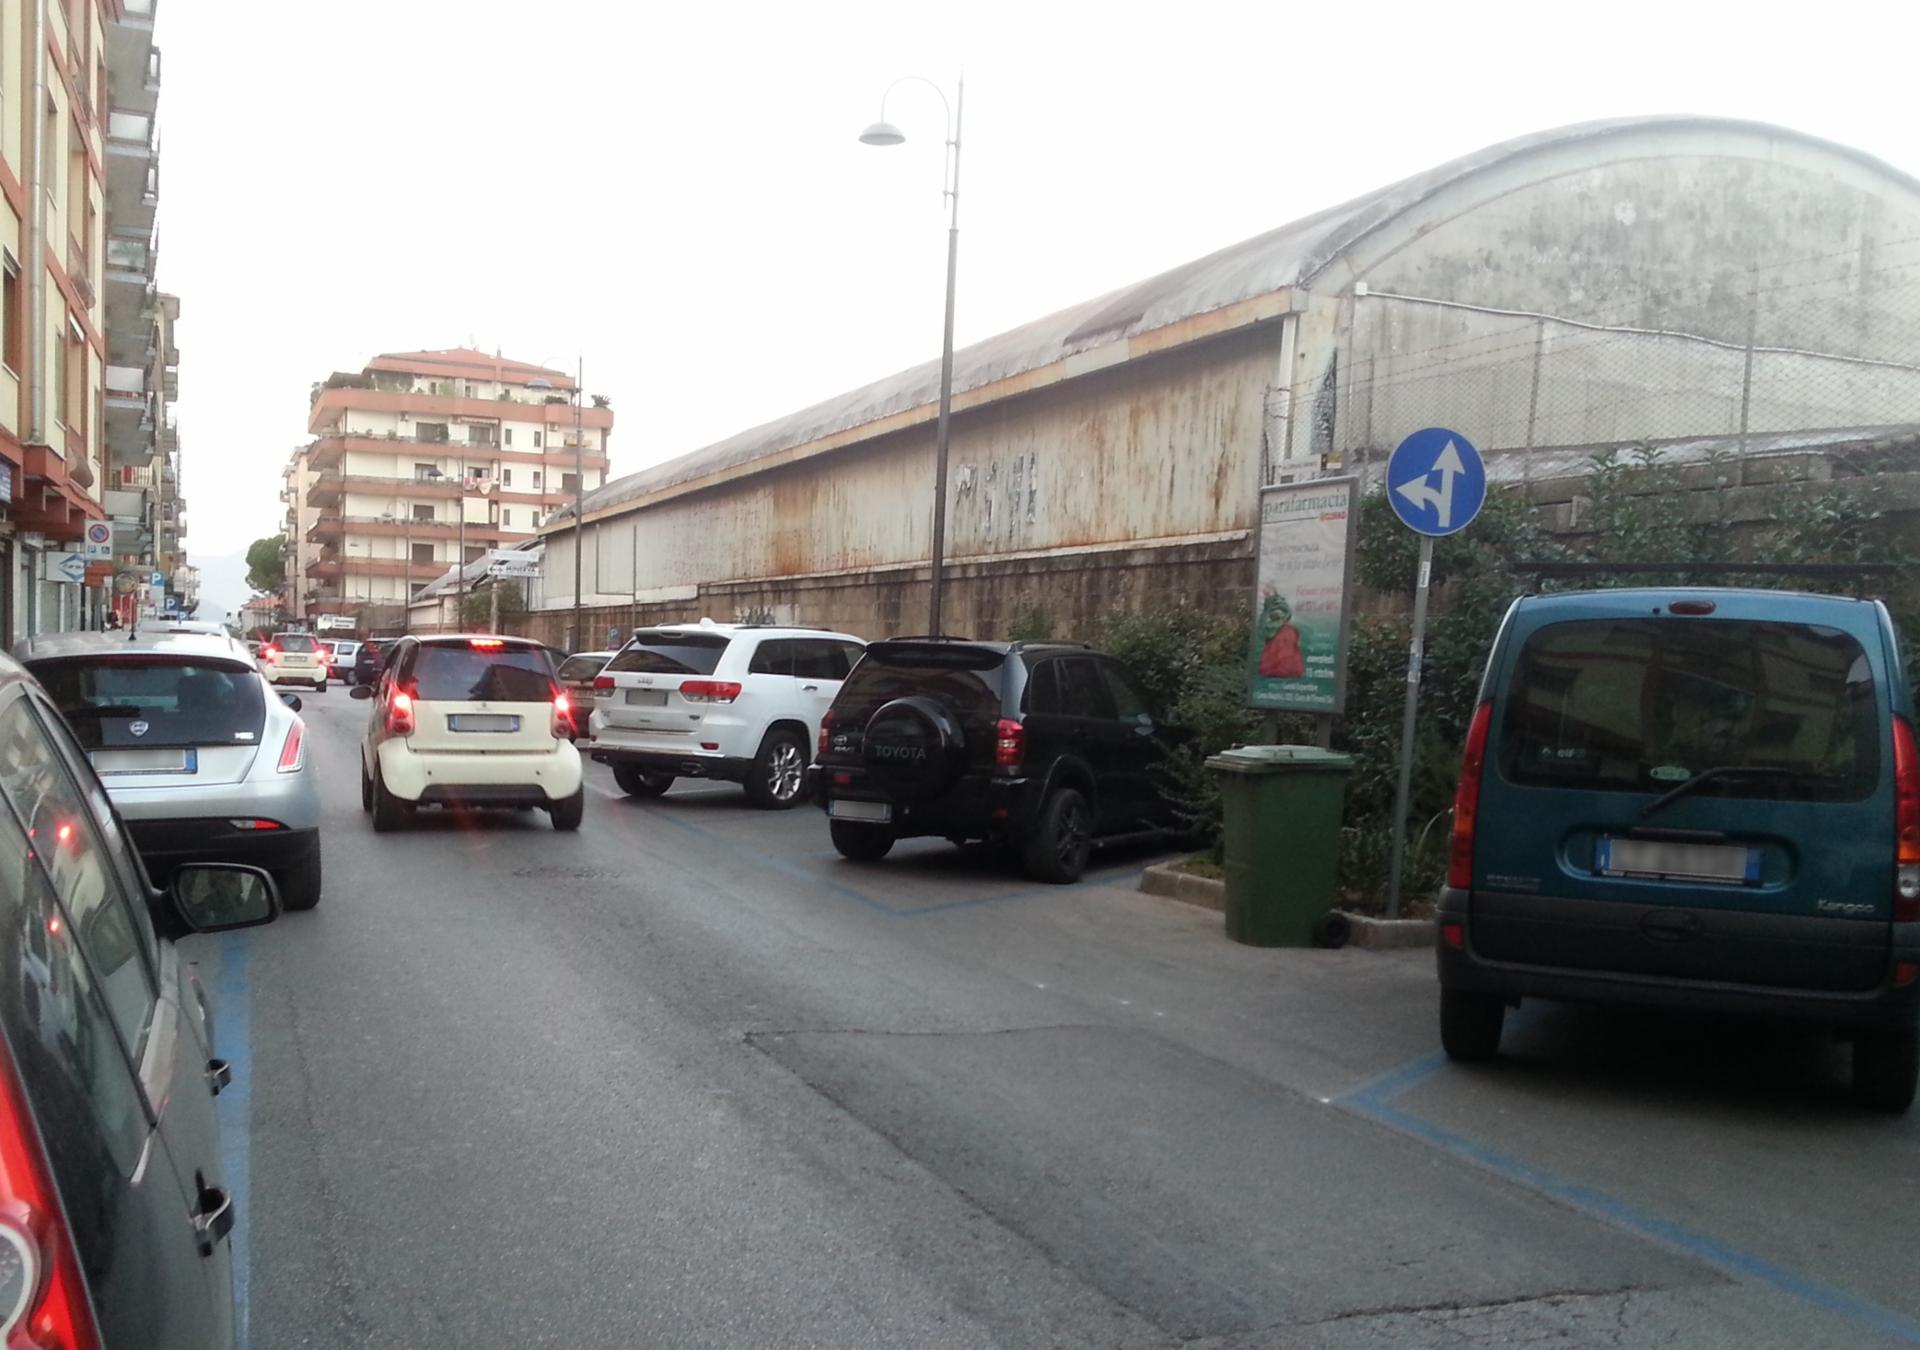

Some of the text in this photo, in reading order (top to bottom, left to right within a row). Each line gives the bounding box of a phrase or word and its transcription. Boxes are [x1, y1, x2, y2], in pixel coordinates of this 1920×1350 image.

[1263, 487, 1347, 521] parafarmacia
[151, 572, 161, 584] P
[165, 599, 175, 610] P
[874, 744, 927, 759] TOYOTA
[1818, 899, 1875, 914] Kangoo
